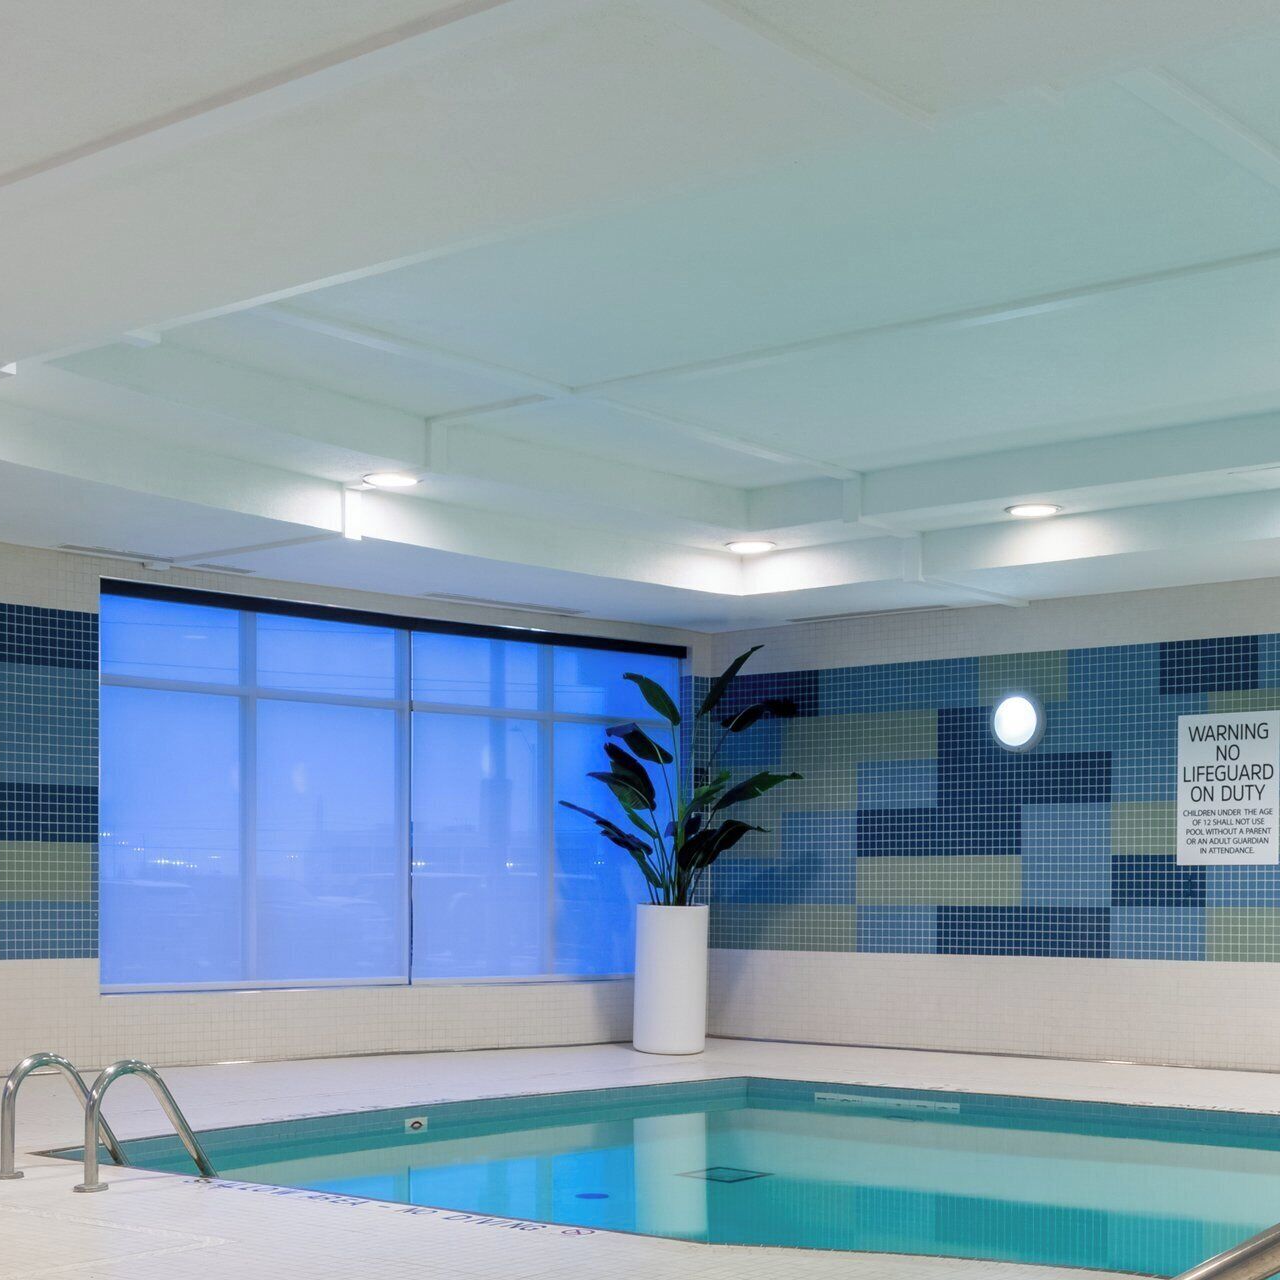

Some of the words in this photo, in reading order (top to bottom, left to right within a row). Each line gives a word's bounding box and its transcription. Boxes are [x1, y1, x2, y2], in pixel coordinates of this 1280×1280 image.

[1188, 722, 1269, 742] WARNING
[1216, 744, 1240, 761] NO
[1183, 763, 1274, 782] LIFEGUARD
[1190, 785, 1214, 802] ON
[1221, 784, 1266, 801] DUTY
[1182, 809, 1216, 817] CHILDREN
[1217, 808, 1241, 816] UNDER
[1259, 807, 1273, 815] AGE
[1212, 818, 1234, 826] SHALL
[1251, 817, 1265, 825] USE
[1245, 827, 1271, 835] PARENT
[1209, 837, 1231, 845] ADULT
[442, 1214, 547, 1232] DIVING
